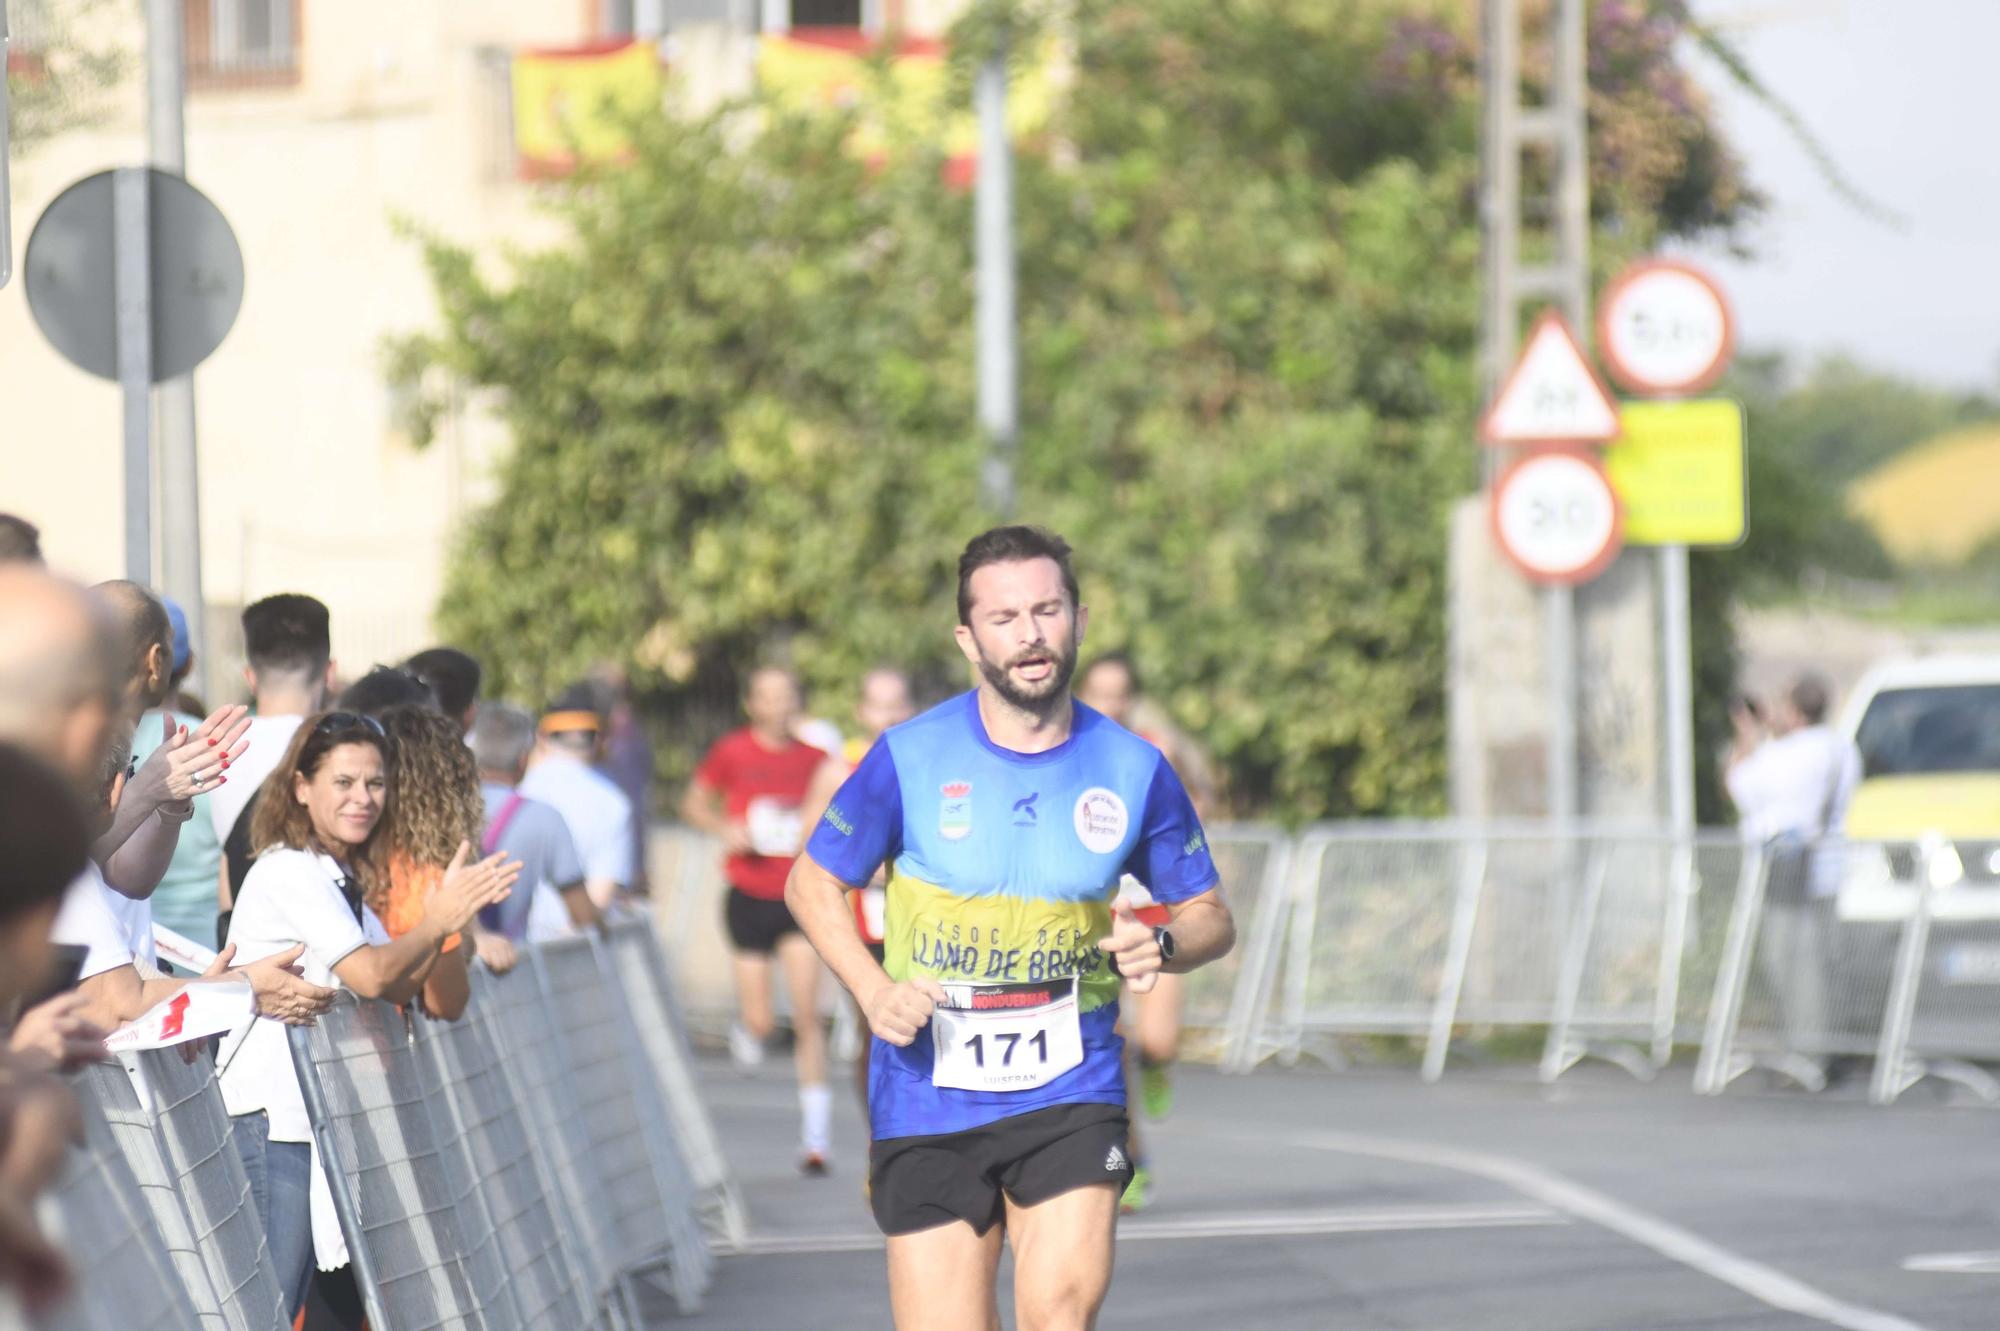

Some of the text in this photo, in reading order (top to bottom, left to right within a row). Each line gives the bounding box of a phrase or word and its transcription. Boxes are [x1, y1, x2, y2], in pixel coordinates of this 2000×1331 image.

[912, 928, 1101, 983] LLANO DE BRUJAS
[964, 1029, 1047, 1067] 171
